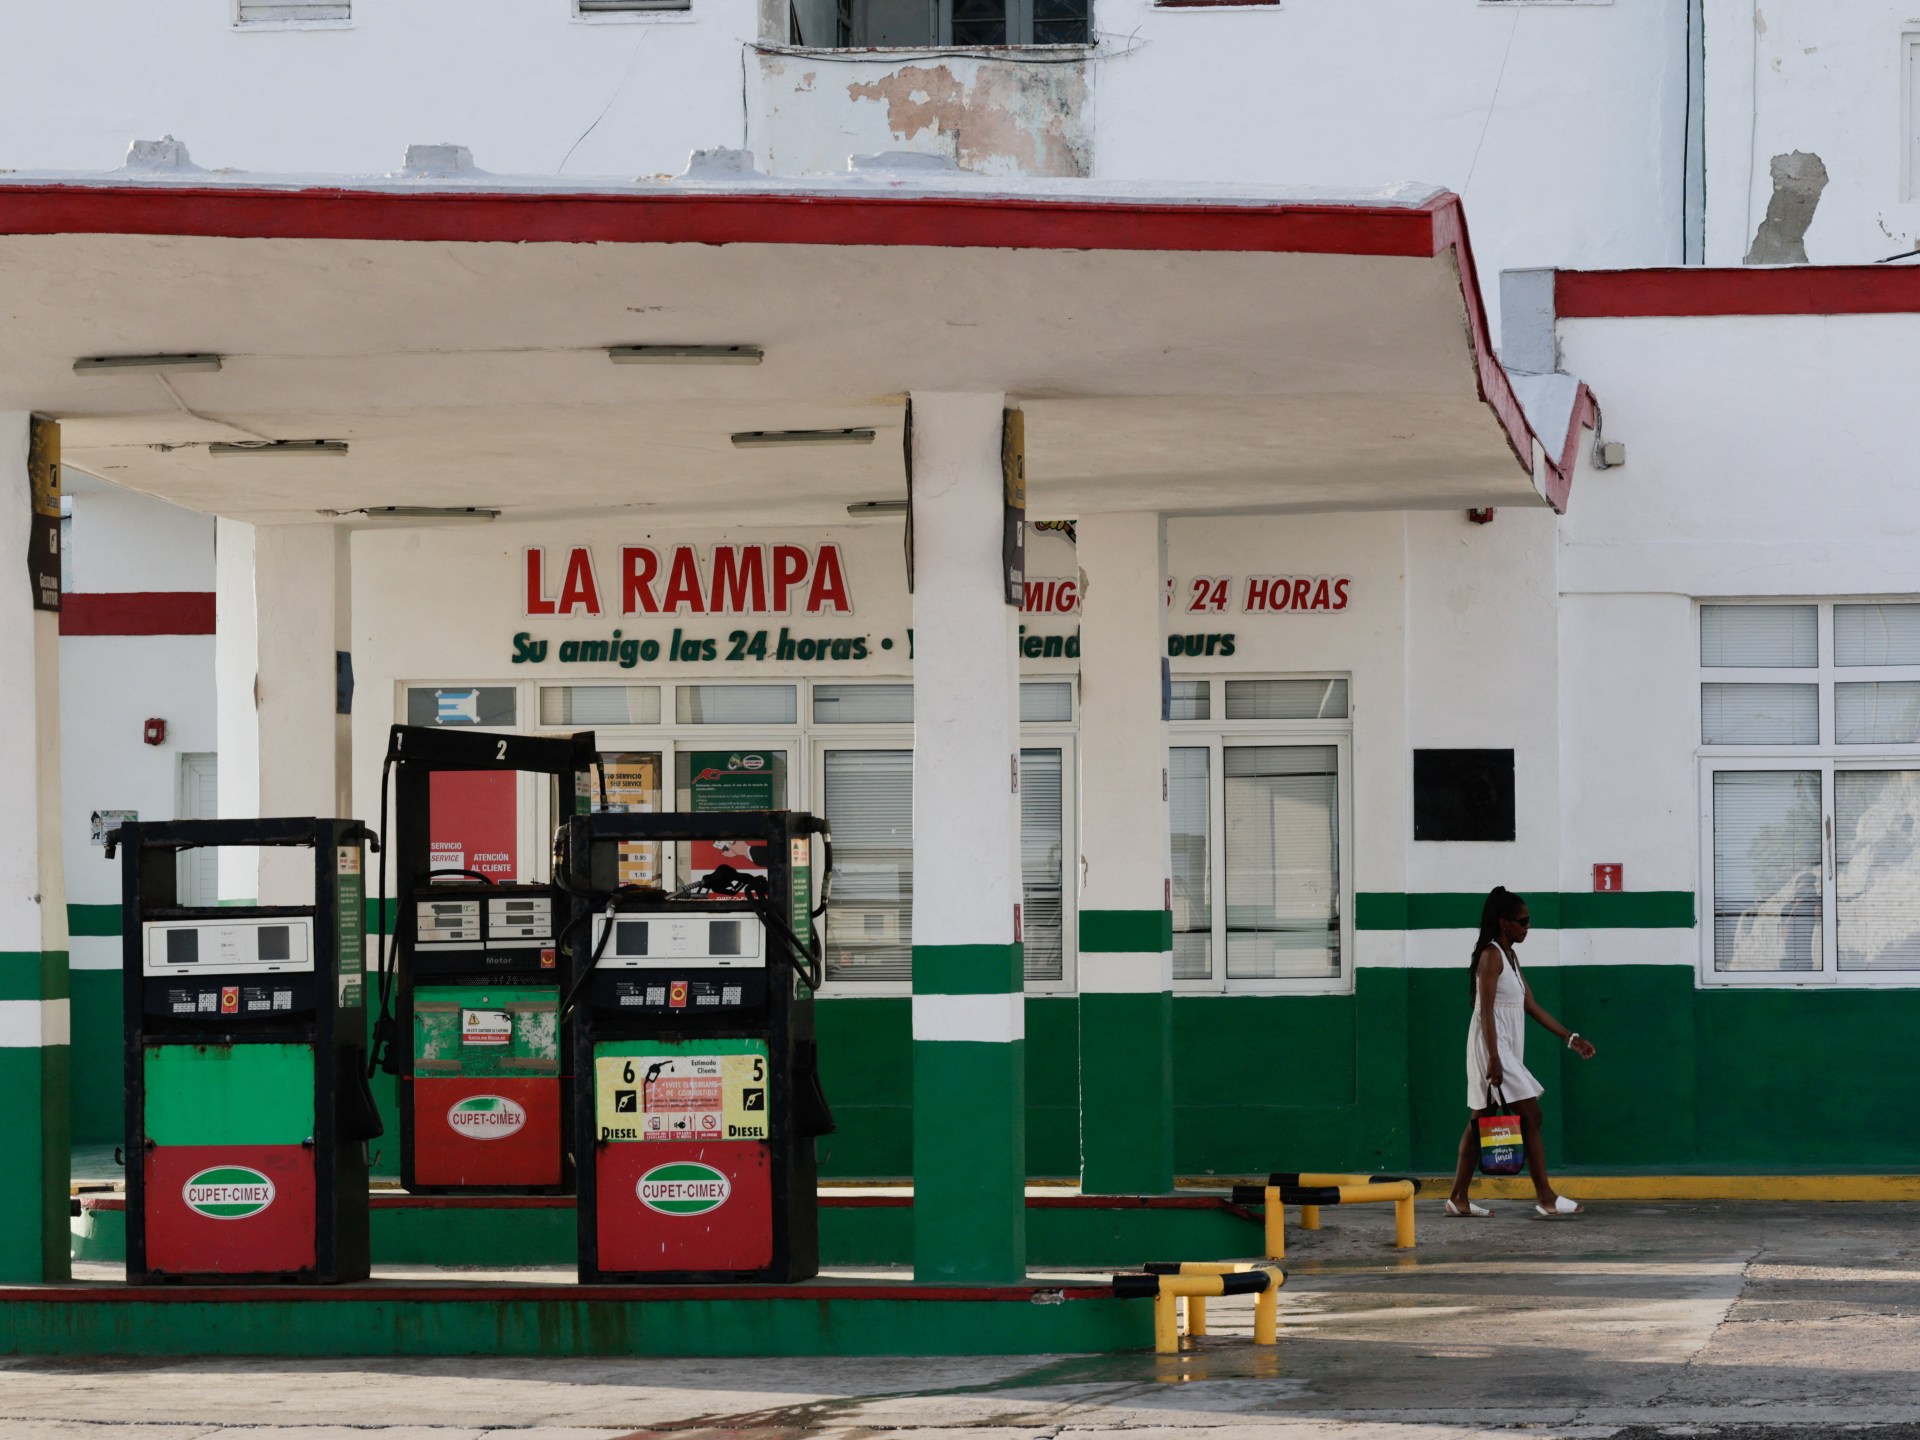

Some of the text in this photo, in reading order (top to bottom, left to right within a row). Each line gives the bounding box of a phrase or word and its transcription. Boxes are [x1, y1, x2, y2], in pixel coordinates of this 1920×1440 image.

[527, 545, 850, 614] LA RAMPA
[1018, 581, 1080, 613] MIG
[1190, 579, 1228, 611] 24
[1247, 578, 1351, 610] HORAS
[512, 632, 548, 664] Su
[559, 629, 659, 668] amigo
[670, 628, 717, 662] las
[725, 630, 767, 661] 24
[776, 628, 867, 660] horas
[1168, 633, 1235, 657] ours
[496, 740, 507, 760] 2
[431, 842, 462, 850] SERVICIO
[431, 854, 459, 862] SERVICE
[473, 852, 509, 861] ATENCIÓN
[471, 864, 511, 872] AL CLIENTE
[623, 1060, 635, 1084] 6
[753, 1058, 763, 1082] 5
[453, 1113, 521, 1125] CUPET-CIMEX
[601, 1126, 637, 1139] DIESEL
[728, 1125, 764, 1137] DIESEL
[189, 1187, 269, 1202] CUPET-CIMEX
[643, 1183, 725, 1198] CUPET-CIMEX
